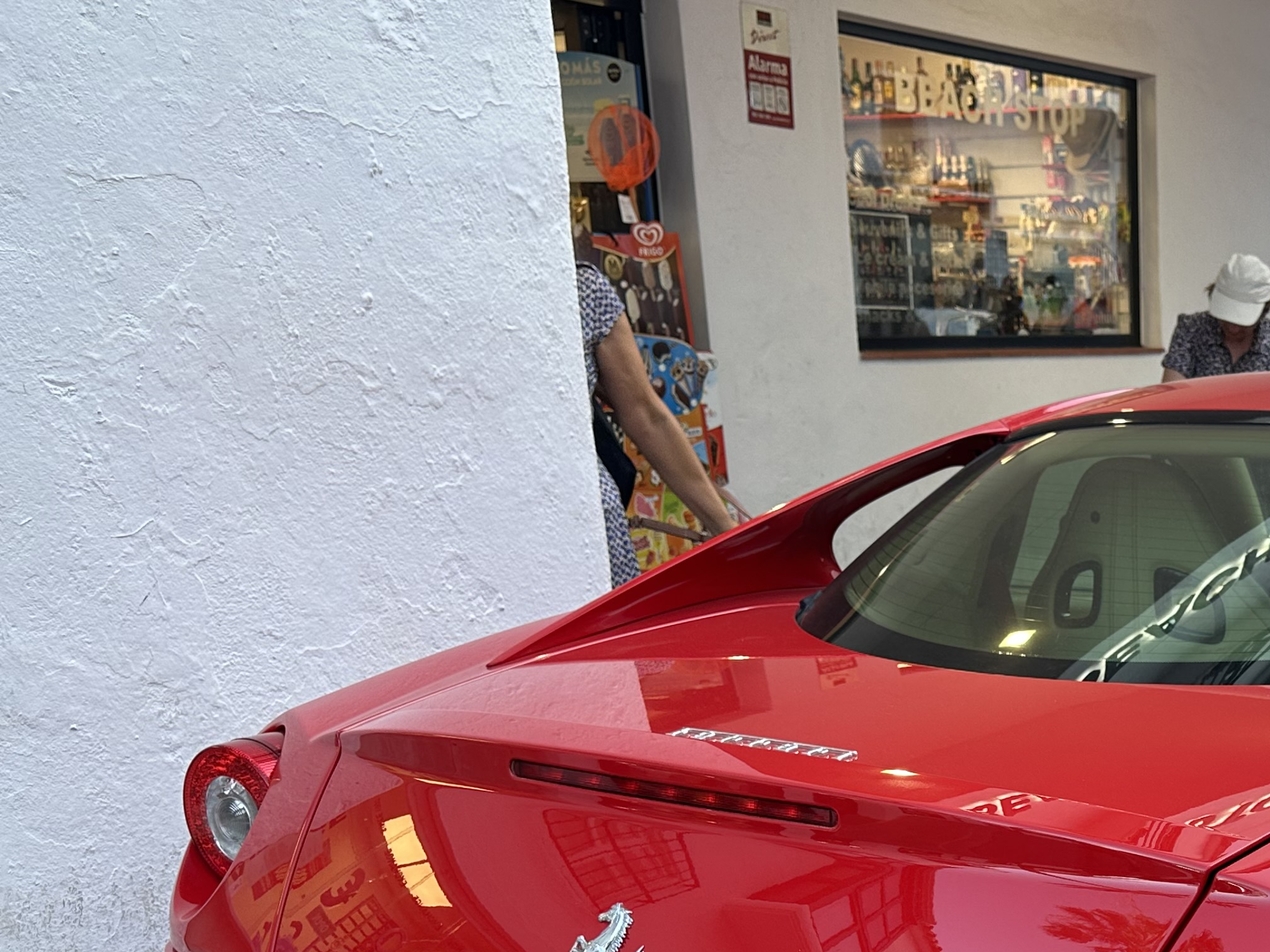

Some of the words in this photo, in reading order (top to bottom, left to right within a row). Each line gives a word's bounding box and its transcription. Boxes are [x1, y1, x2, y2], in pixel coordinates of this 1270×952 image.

[748, 54, 788, 77] Alarma
[895, 71, 1004, 126] BEACH
[1013, 91, 1087, 138] STOP
